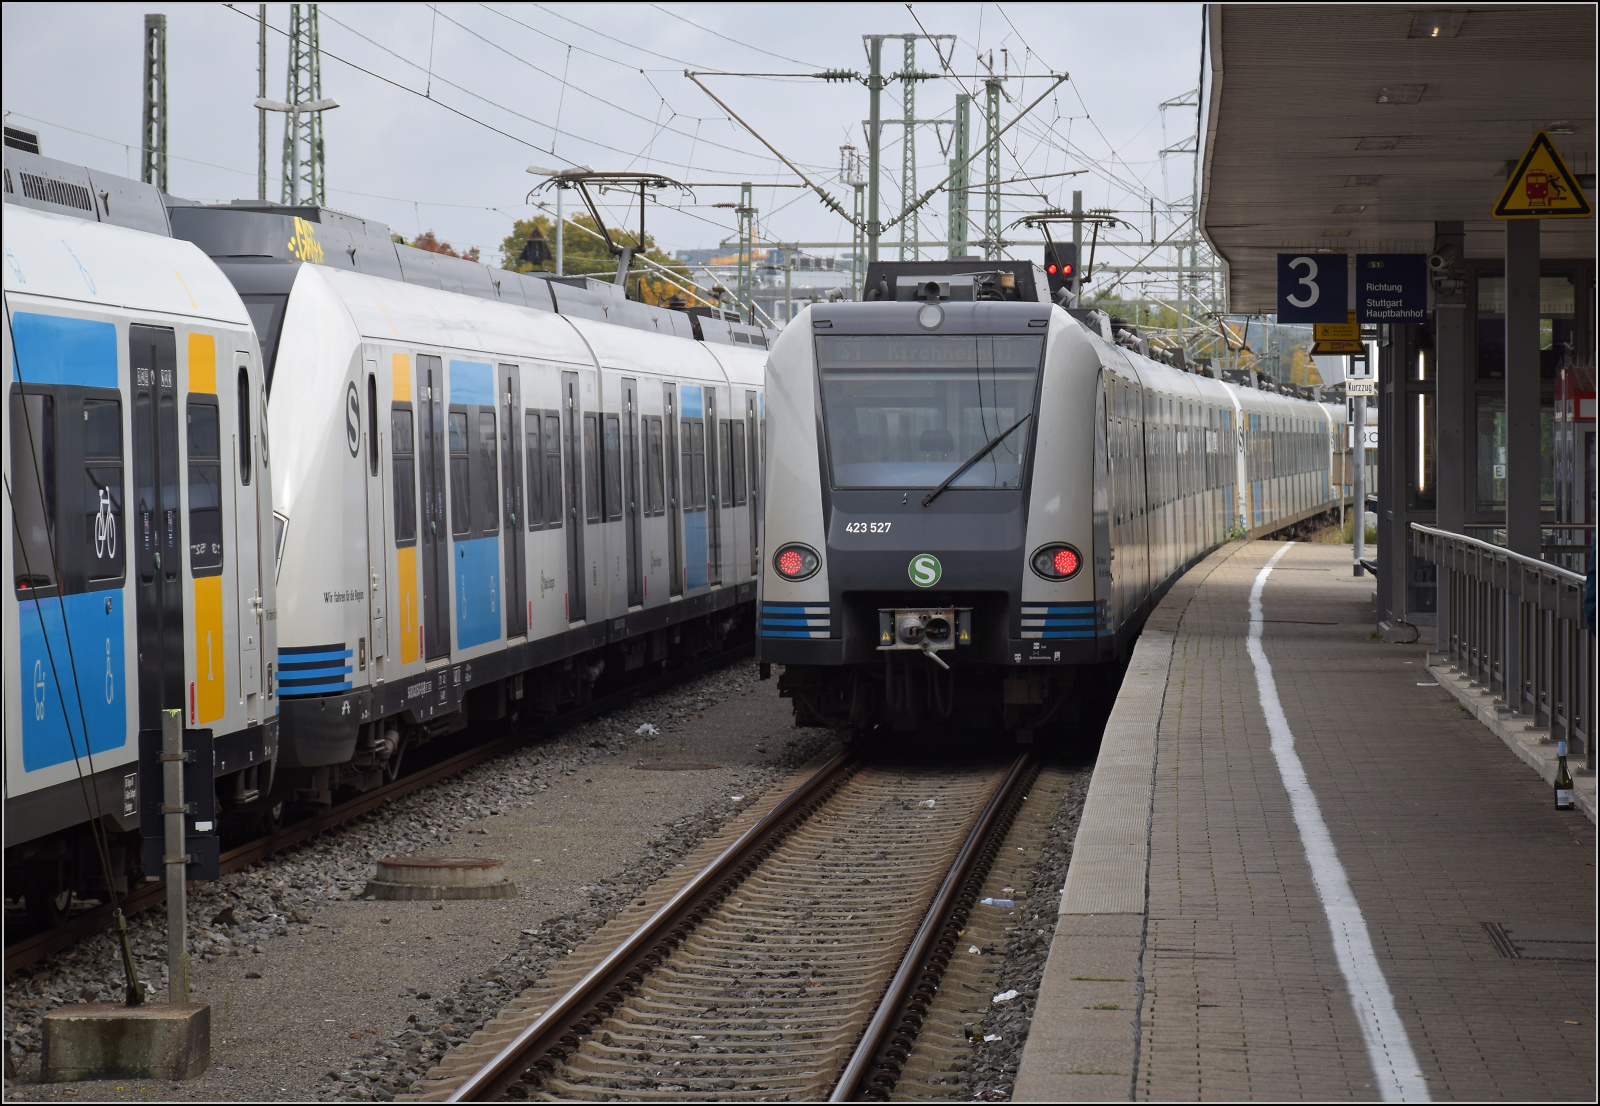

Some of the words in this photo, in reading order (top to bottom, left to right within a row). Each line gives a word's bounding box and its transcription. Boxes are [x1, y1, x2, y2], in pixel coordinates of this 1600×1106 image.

[1286, 256, 1320, 308] 3
[1366, 283, 1403, 293] Richtung
[1366, 298, 1403, 309] Stuttgart
[1366, 309, 1424, 319] Hauptbahnhof
[1348, 381, 1373, 394] Kurzzug
[1495, 466, 1503, 477] E
[845, 522, 868, 533] 423
[870, 522, 892, 533] 527
[913, 557, 937, 585] S
[206, 629, 214, 681] 1
